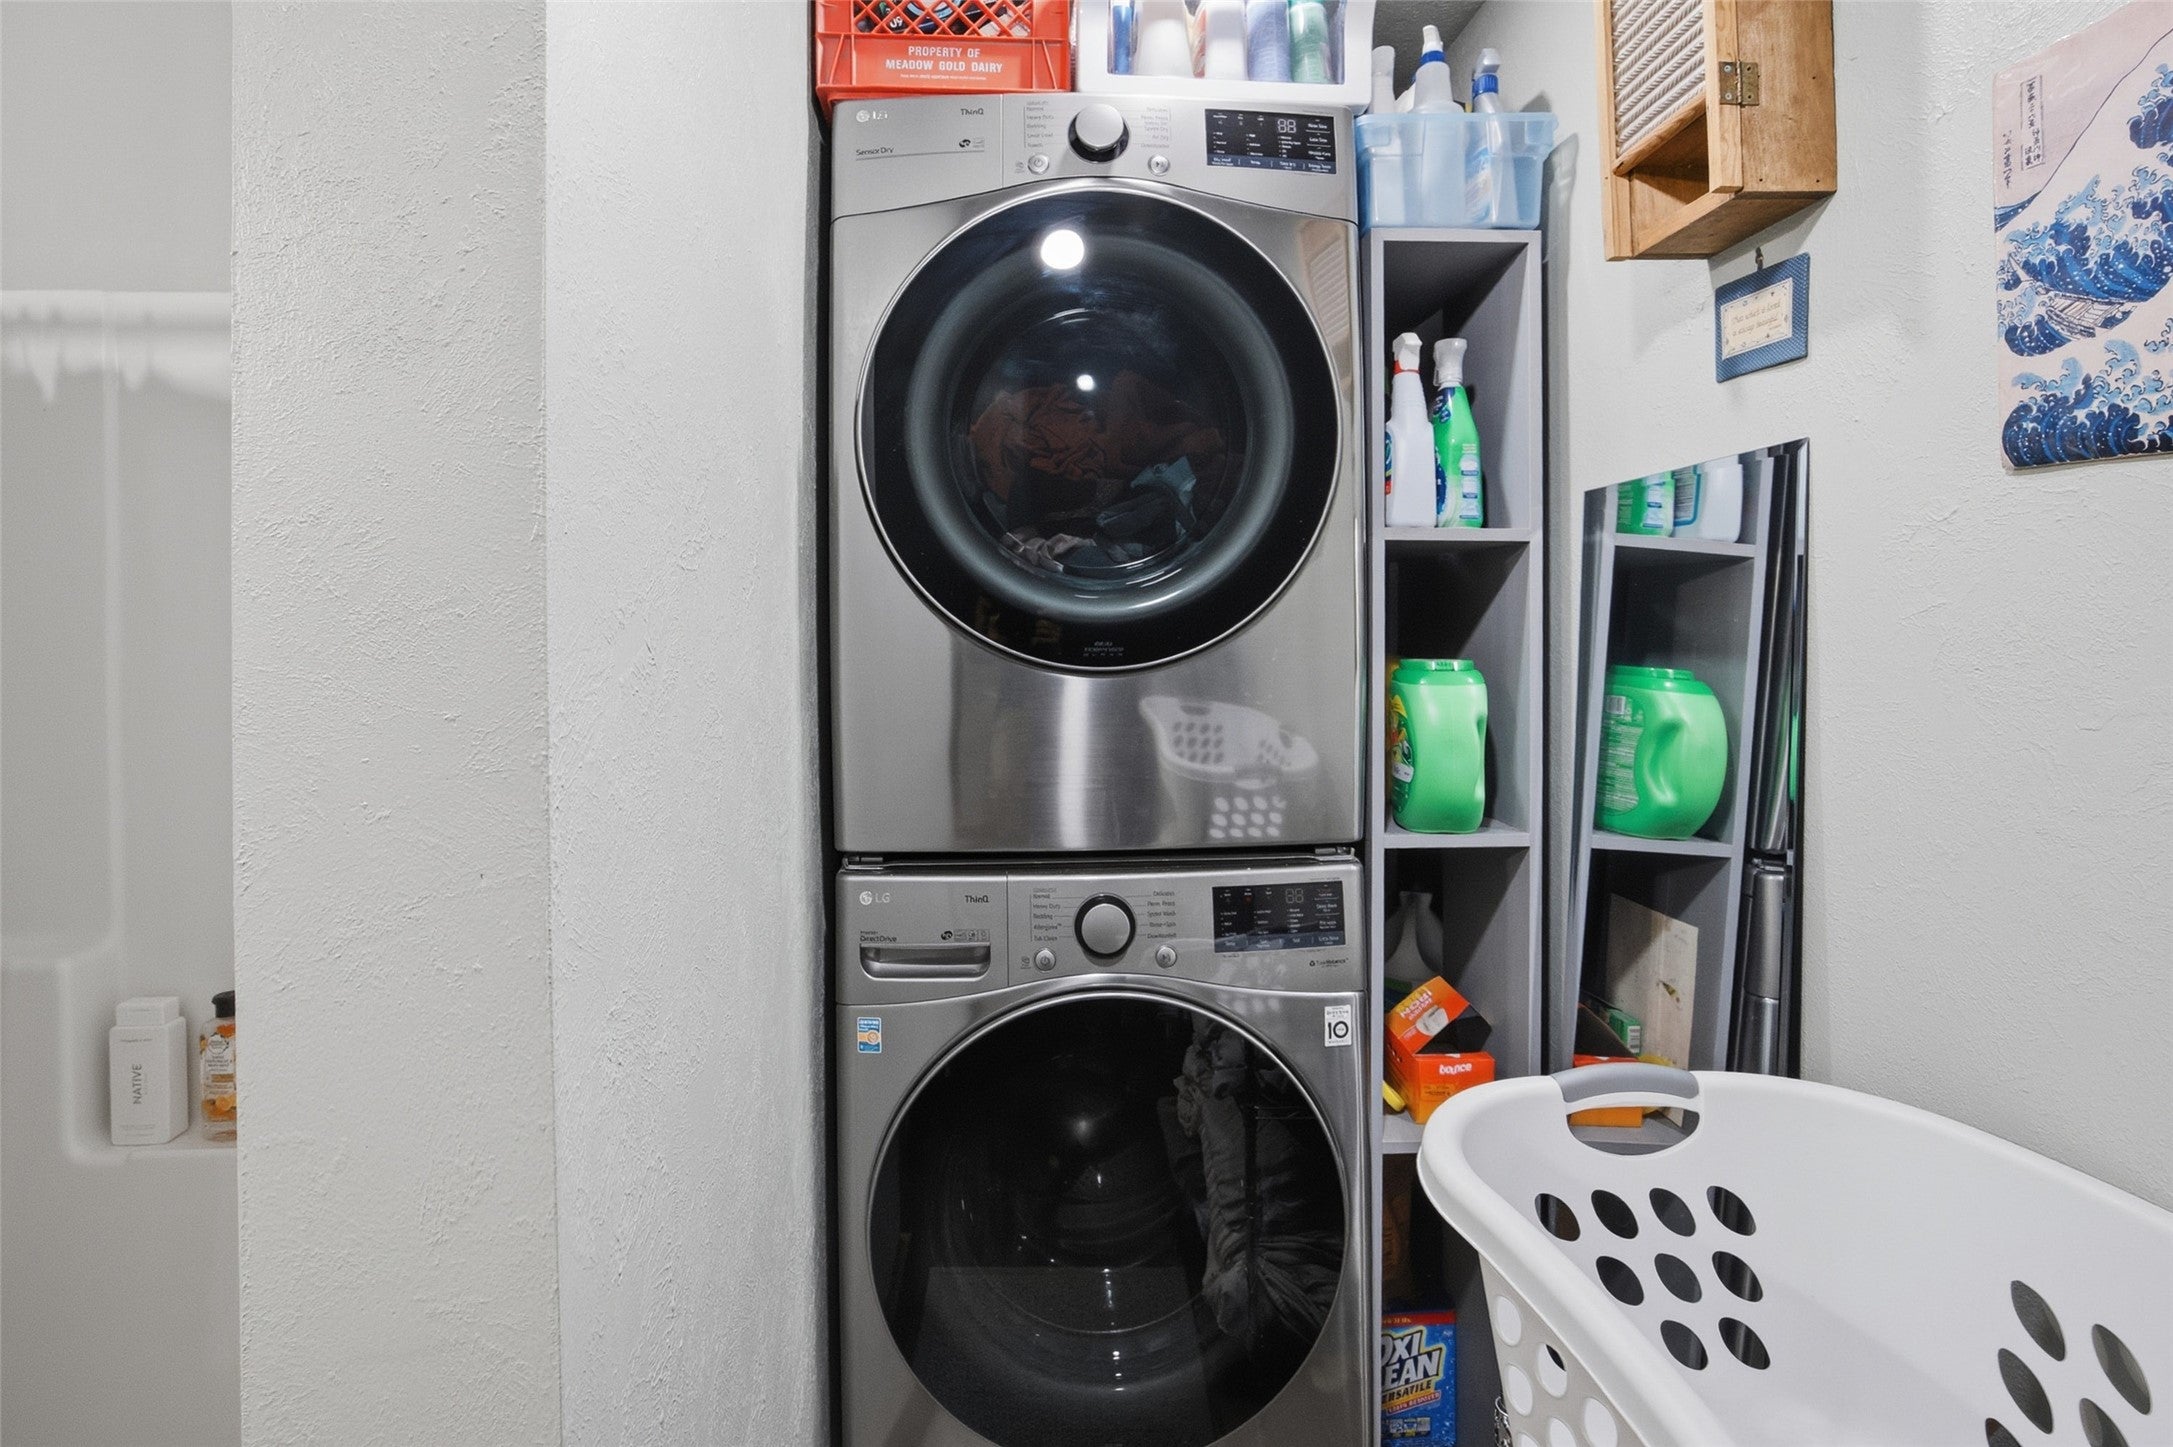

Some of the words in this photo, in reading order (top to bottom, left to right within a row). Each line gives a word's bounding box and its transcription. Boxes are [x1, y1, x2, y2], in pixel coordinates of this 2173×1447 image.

[908, 46, 963, 58] PROPERTY
[967, 48, 981, 58] OF
[885, 59, 934, 70] MEADOW
[938, 61, 966, 72] GOLD
[971, 61, 1004, 73] DAIRY
[960, 108, 984, 116] ThinQ
[856, 148, 880, 156] Sensor
[875, 892, 891, 903] LG
[964, 895, 990, 903] ThinQ
[1439, 1063, 1473, 1075] bounce
[132, 1063, 142, 1105] NATIVE
